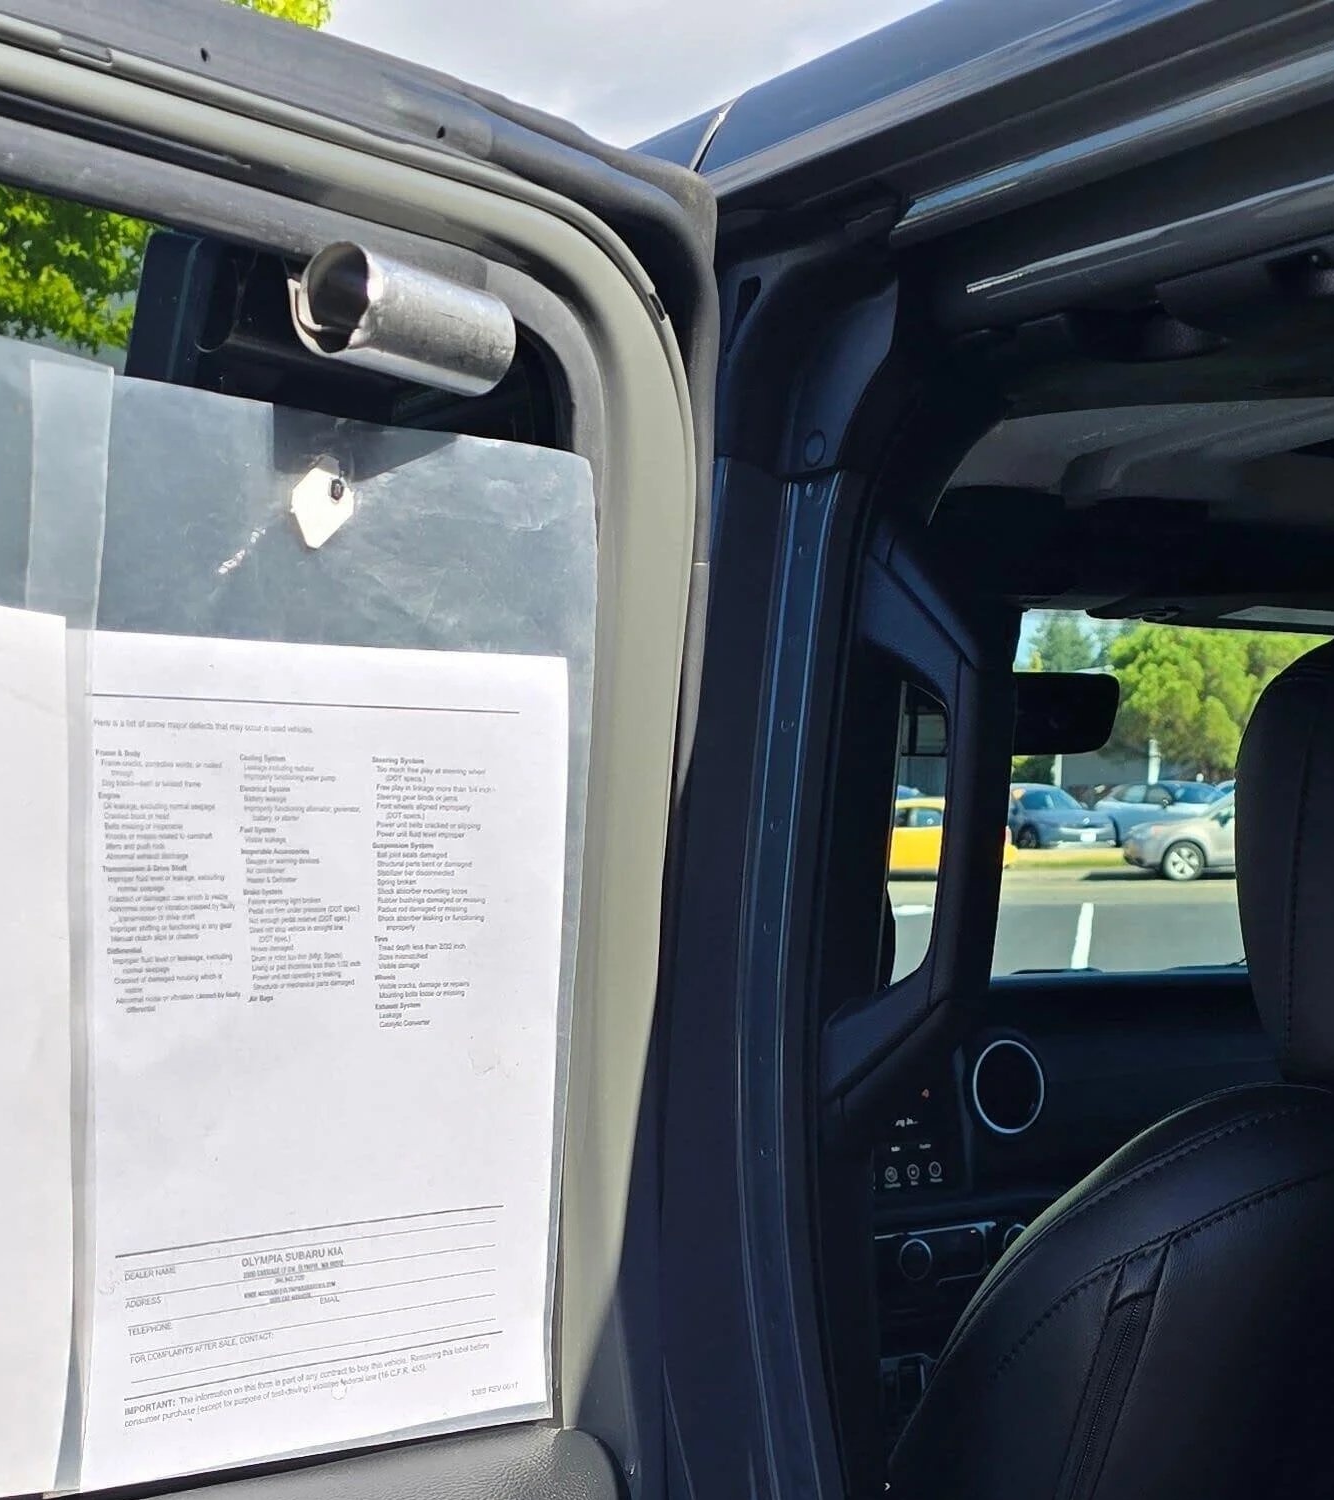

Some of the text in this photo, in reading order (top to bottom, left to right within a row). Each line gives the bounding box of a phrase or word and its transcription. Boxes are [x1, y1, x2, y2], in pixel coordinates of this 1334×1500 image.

[400, 756, 424, 766] System
[242, 1247, 344, 1267] OLYMPIA SUBARU KIA
[124, 1267, 176, 1281] DEALER NAME
[125, 1297, 162, 1309] ADDRESS
[320, 1296, 340, 1305] EMAIL
[128, 1322, 172, 1336] TELEPHONE
[130, 1332, 274, 1364] FOR COMPLAINTS AFTER SALE, CONTACT:
[124, 1400, 176, 1415] IMPORTANT:
[195, 1389, 232, 1402] information
[282, 1376, 296, 1388] part
[297, 1375, 304, 1383] of
[162, 1409, 196, 1422] purchase
